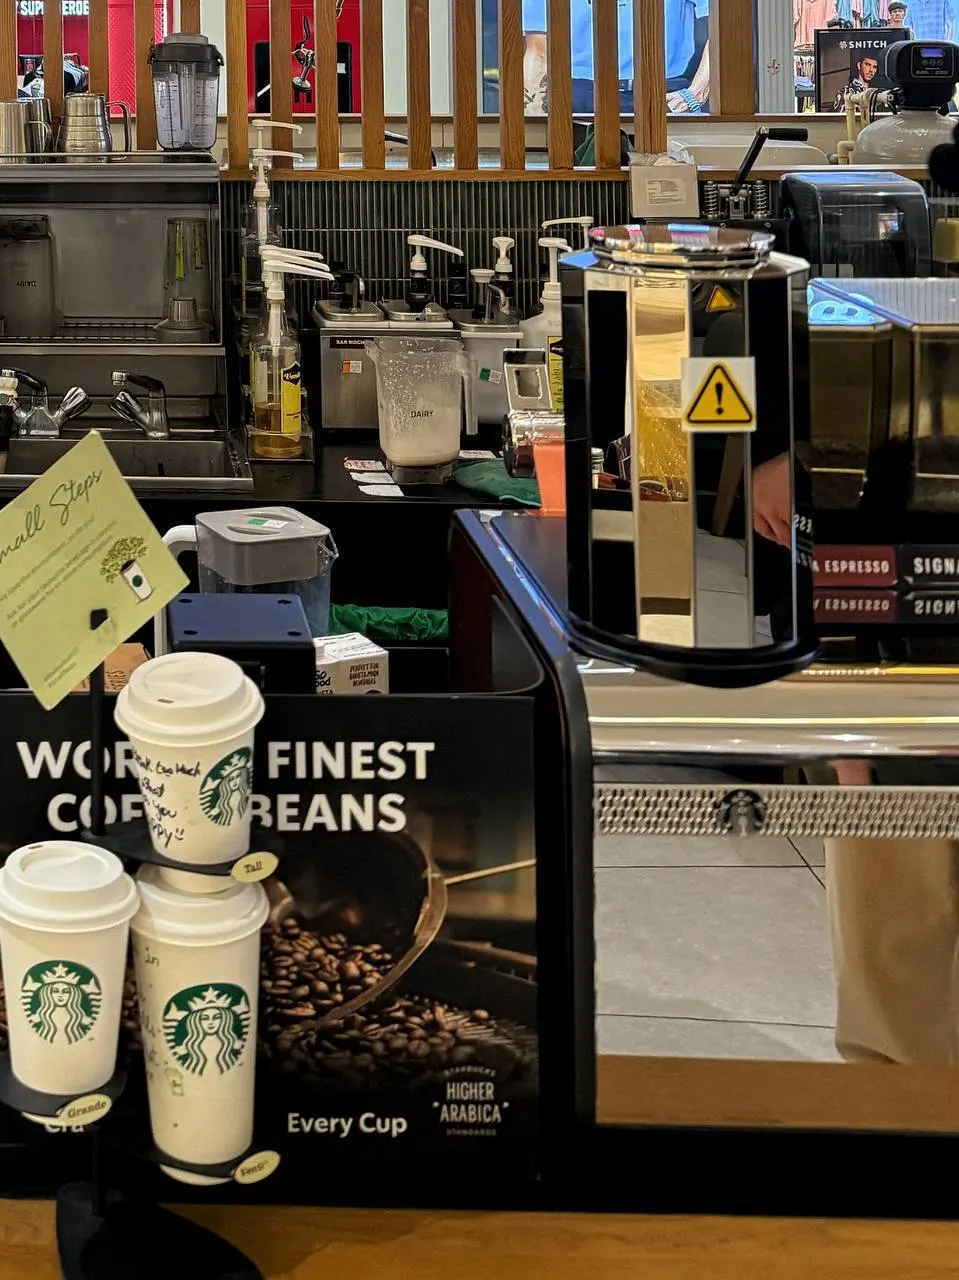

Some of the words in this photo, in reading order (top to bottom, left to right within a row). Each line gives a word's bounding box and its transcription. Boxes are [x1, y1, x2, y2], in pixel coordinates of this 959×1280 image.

[848, 40, 887, 49] SNITCH
[410, 410, 434, 418] DAIRY
[49, 469, 103, 526] Steps
[824, 560, 889, 573] ESPRESSO
[315, 677, 331, 688] ood
[268, 740, 436, 780] FINEST
[250, 793, 408, 833] BEANS
[244, 861, 263, 874] Tall
[446, 1082, 494, 1101] HIGHER
[67, 1099, 108, 1119] Grande
[440, 1104, 501, 1123] ARABICA
[288, 1112, 353, 1138] Every
[359, 1112, 407, 1137] Cup
